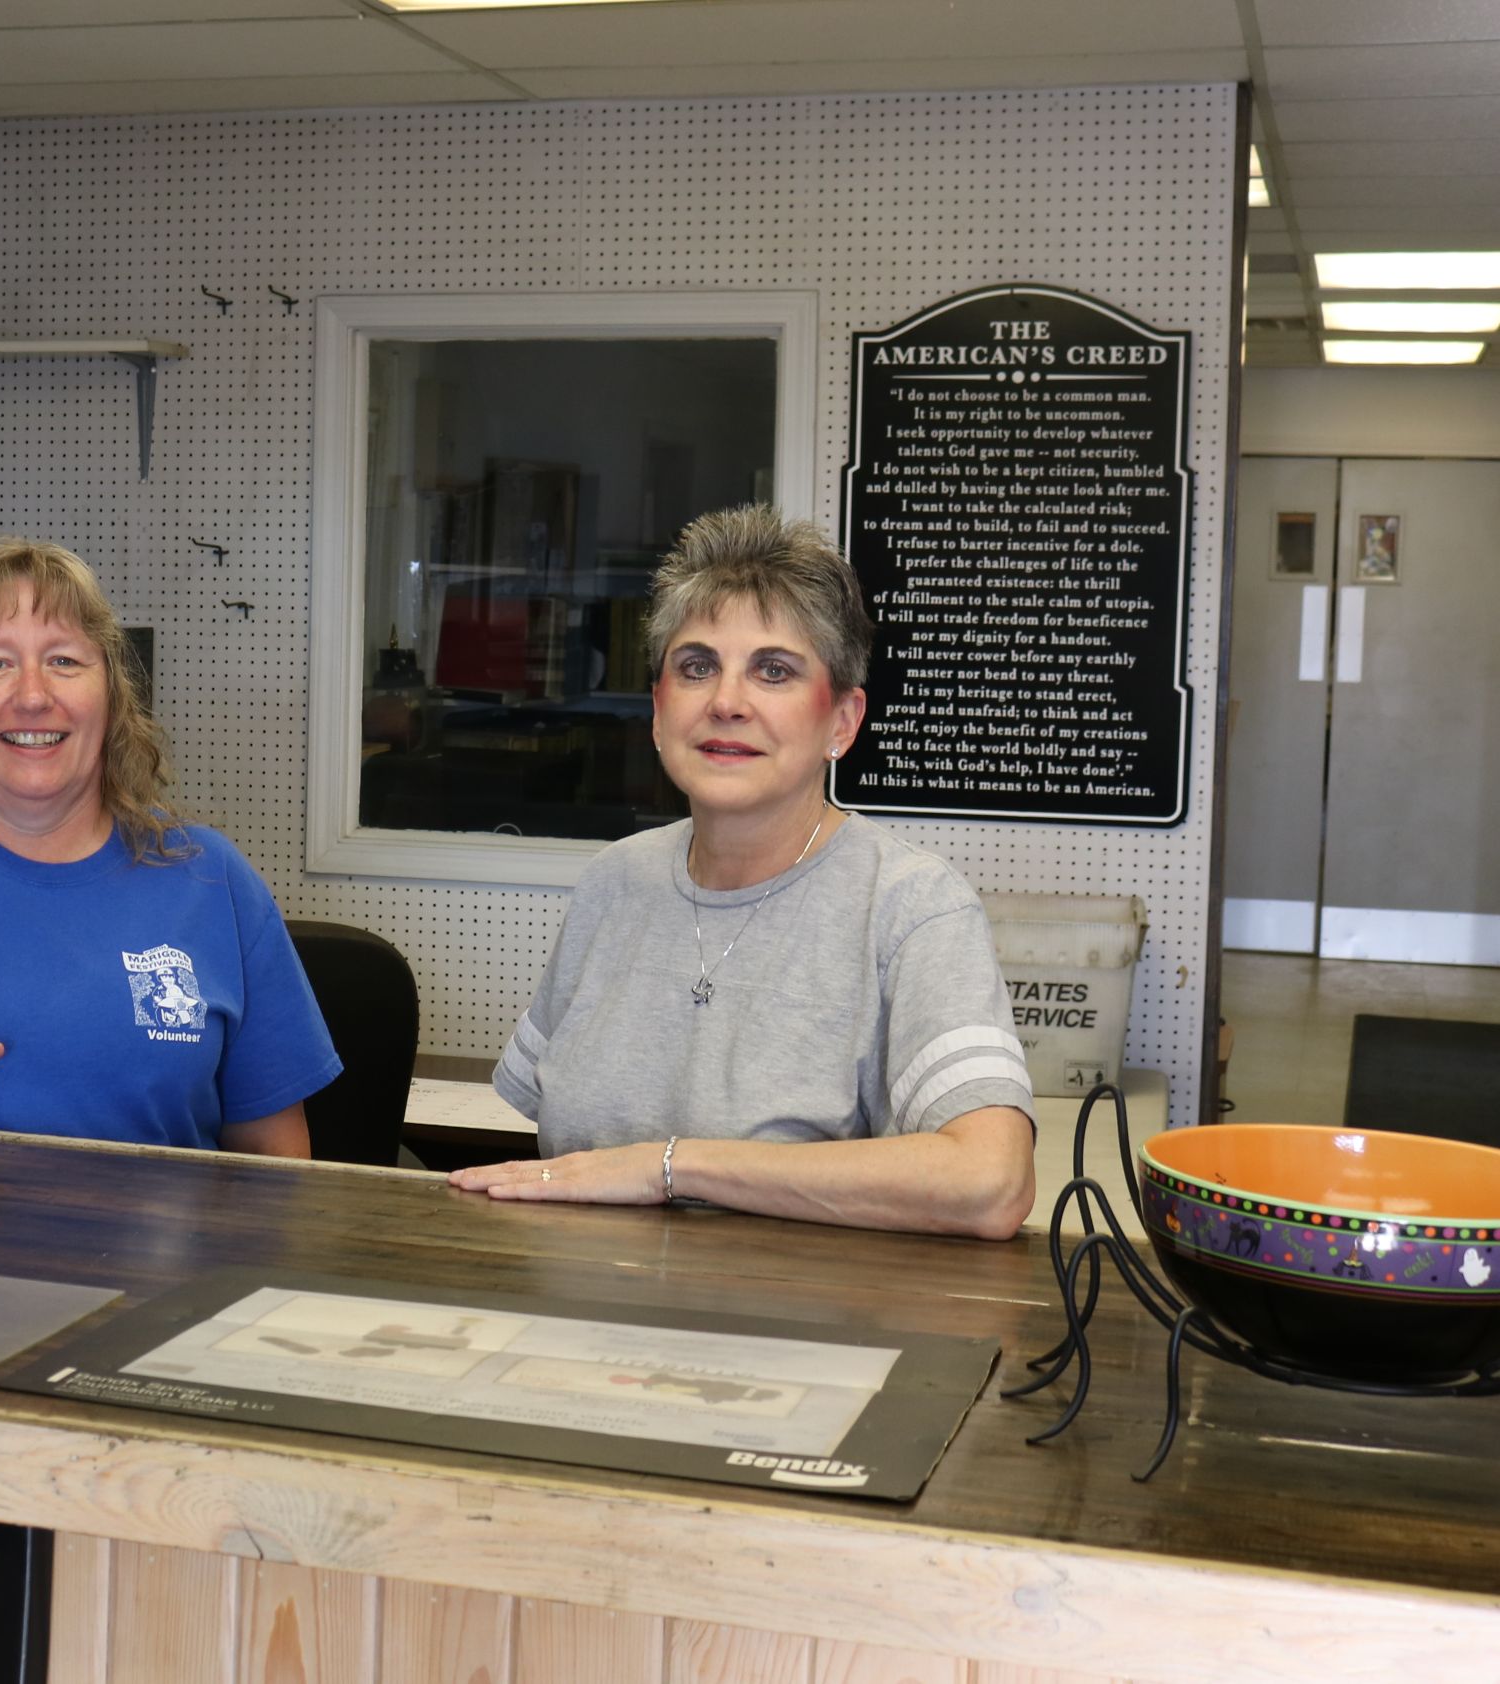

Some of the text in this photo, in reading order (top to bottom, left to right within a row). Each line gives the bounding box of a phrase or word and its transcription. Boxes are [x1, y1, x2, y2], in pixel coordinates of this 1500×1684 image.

[989, 321, 1050, 340] THE
[872, 345, 1167, 365] AMERICAN'S CREED
[907, 388, 924, 401] do
[928, 391, 949, 401] not
[954, 388, 1000, 401] choose
[1004, 391, 1018, 401] to
[1022, 388, 1038, 401] be
[1042, 392, 1050, 401] a
[1054, 392, 1112, 401] common
[1117, 392, 1151, 401] man.
[914, 406, 1124, 423] It is my right to be uncommon.
[886, 425, 1152, 442] I seek opportunity to develop whatever
[898, 443, 944, 456] talents
[948, 443, 975, 457] God
[979, 448, 1009, 461] gave
[1014, 448, 1034, 457] me
[1053, 448, 1076, 458] not
[1080, 445, 1138, 461] security.
[902, 499, 1131, 517] I want to take the calculated risk;
[887, 535, 1143, 553] I refuse to barter incentive for a dole.
[907, 573, 1120, 590] guaranteed existence: the thrill
[873, 590, 1154, 613] of fulfillment to the stale calm of utopia.
[878, 608, 1148, 628] I will not trade freedom for beneficence
[912, 629, 1111, 647] nor my dignity for a handout.
[887, 645, 1136, 668] I will never cower before any earthly
[906, 666, 1113, 685] master nor bend to any threat.
[902, 682, 1116, 704] It is my heritage to stand erect,
[886, 700, 1132, 721] proud and unafraid; to think and act
[870, 718, 1148, 741] myself, enjoy the benefit of my creations
[886, 755, 919, 771] This,
[924, 756, 953, 770] with
[957, 757, 995, 772] God's
[999, 759, 1032, 777] help,
[1037, 760, 1043, 774] I
[1047, 761, 1078, 775] have
[129, 959, 173, 970] FESTIVAL
[1005, 980, 1089, 1003] TATES
[1011, 1006, 1098, 1029] ERVICE
[147, 1029, 201, 1043] Volunteer
[179, 1391, 238, 1406] Brake
[726, 1450, 866, 1476] Bendix
